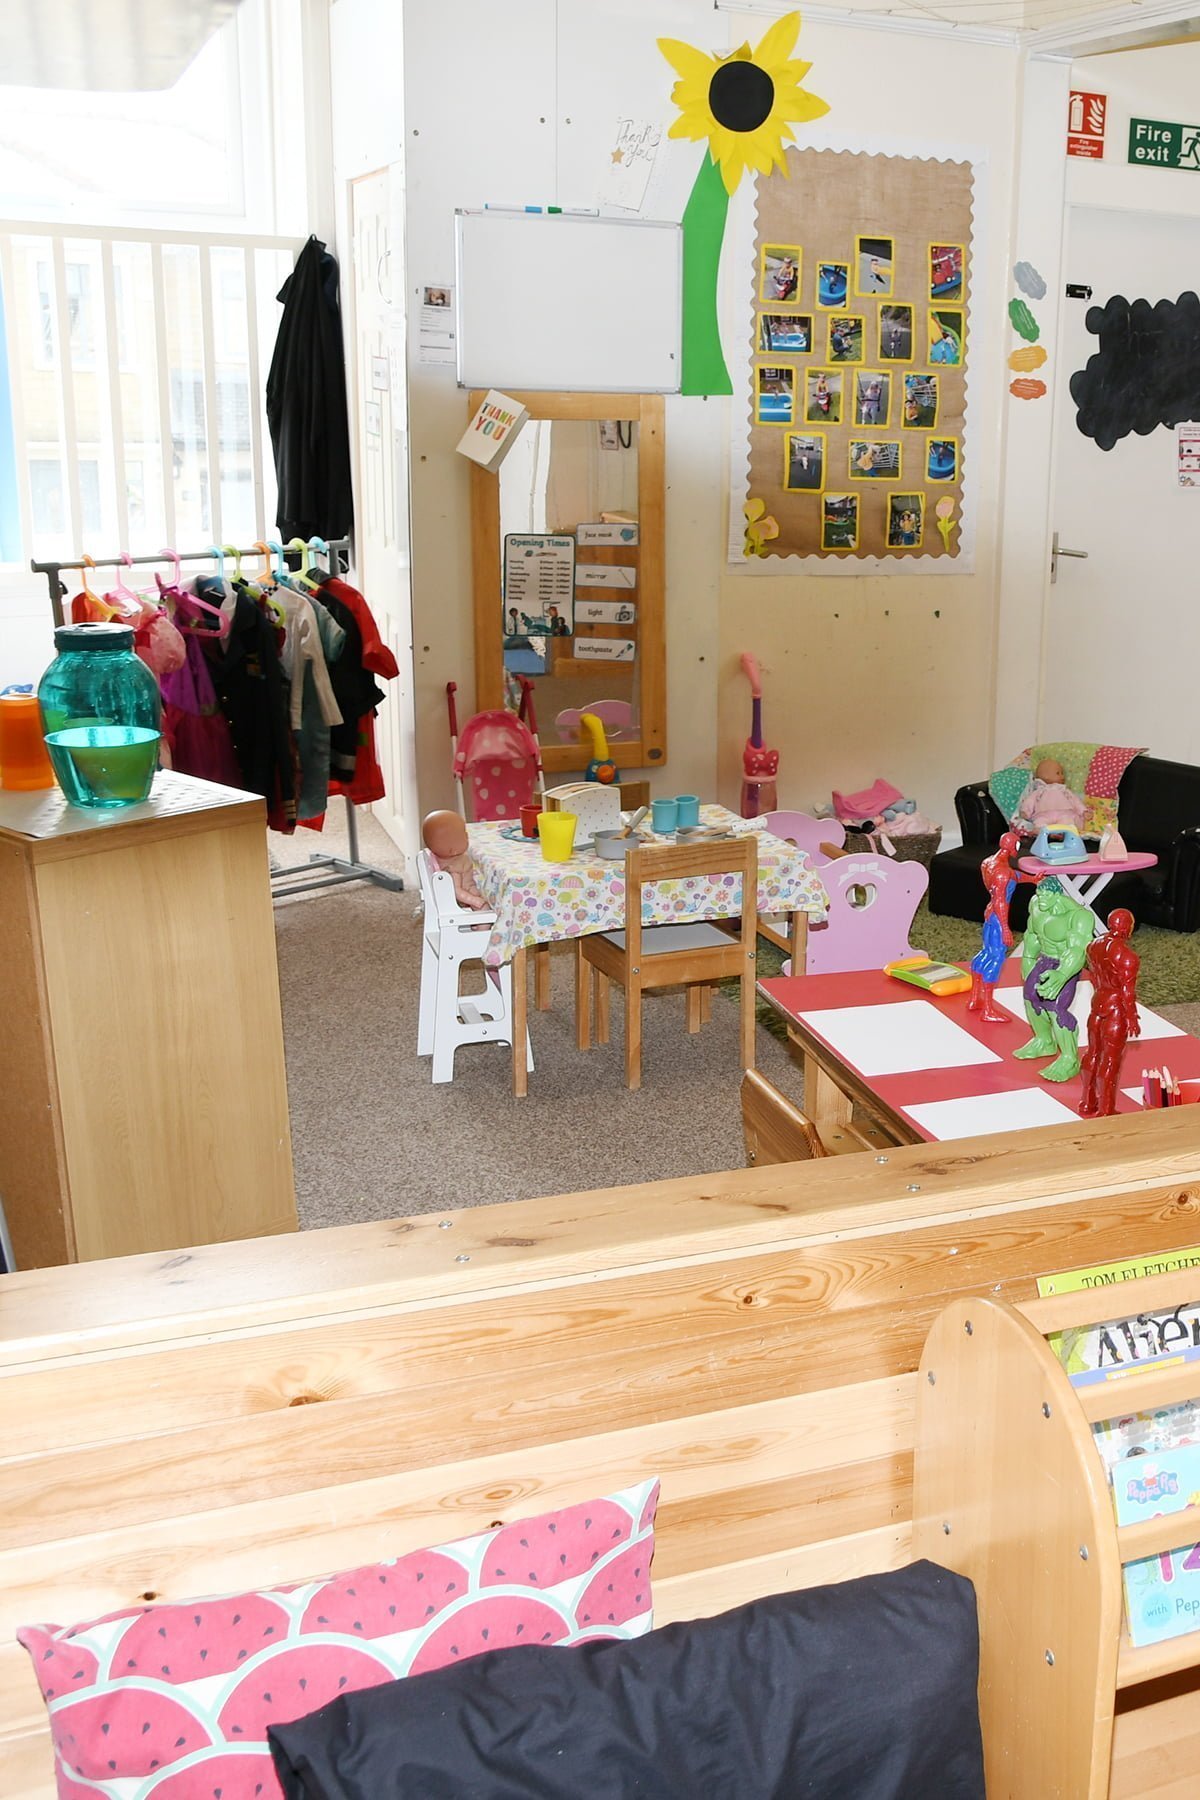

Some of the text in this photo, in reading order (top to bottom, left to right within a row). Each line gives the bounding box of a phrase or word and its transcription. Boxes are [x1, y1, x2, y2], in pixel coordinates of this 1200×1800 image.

[1136, 124, 1172, 143] Fire
[1135, 146, 1169, 162] exit
[481, 402, 516, 427] THANK
[475, 415, 506, 441] YOU
[510, 538, 570, 548] Opening Times
[587, 608, 603, 616] light
[1081, 1271, 1117, 1289] TOM
[1128, 1473, 1179, 1502] Peppa Pig
[1146, 1605, 1169, 1617] with
